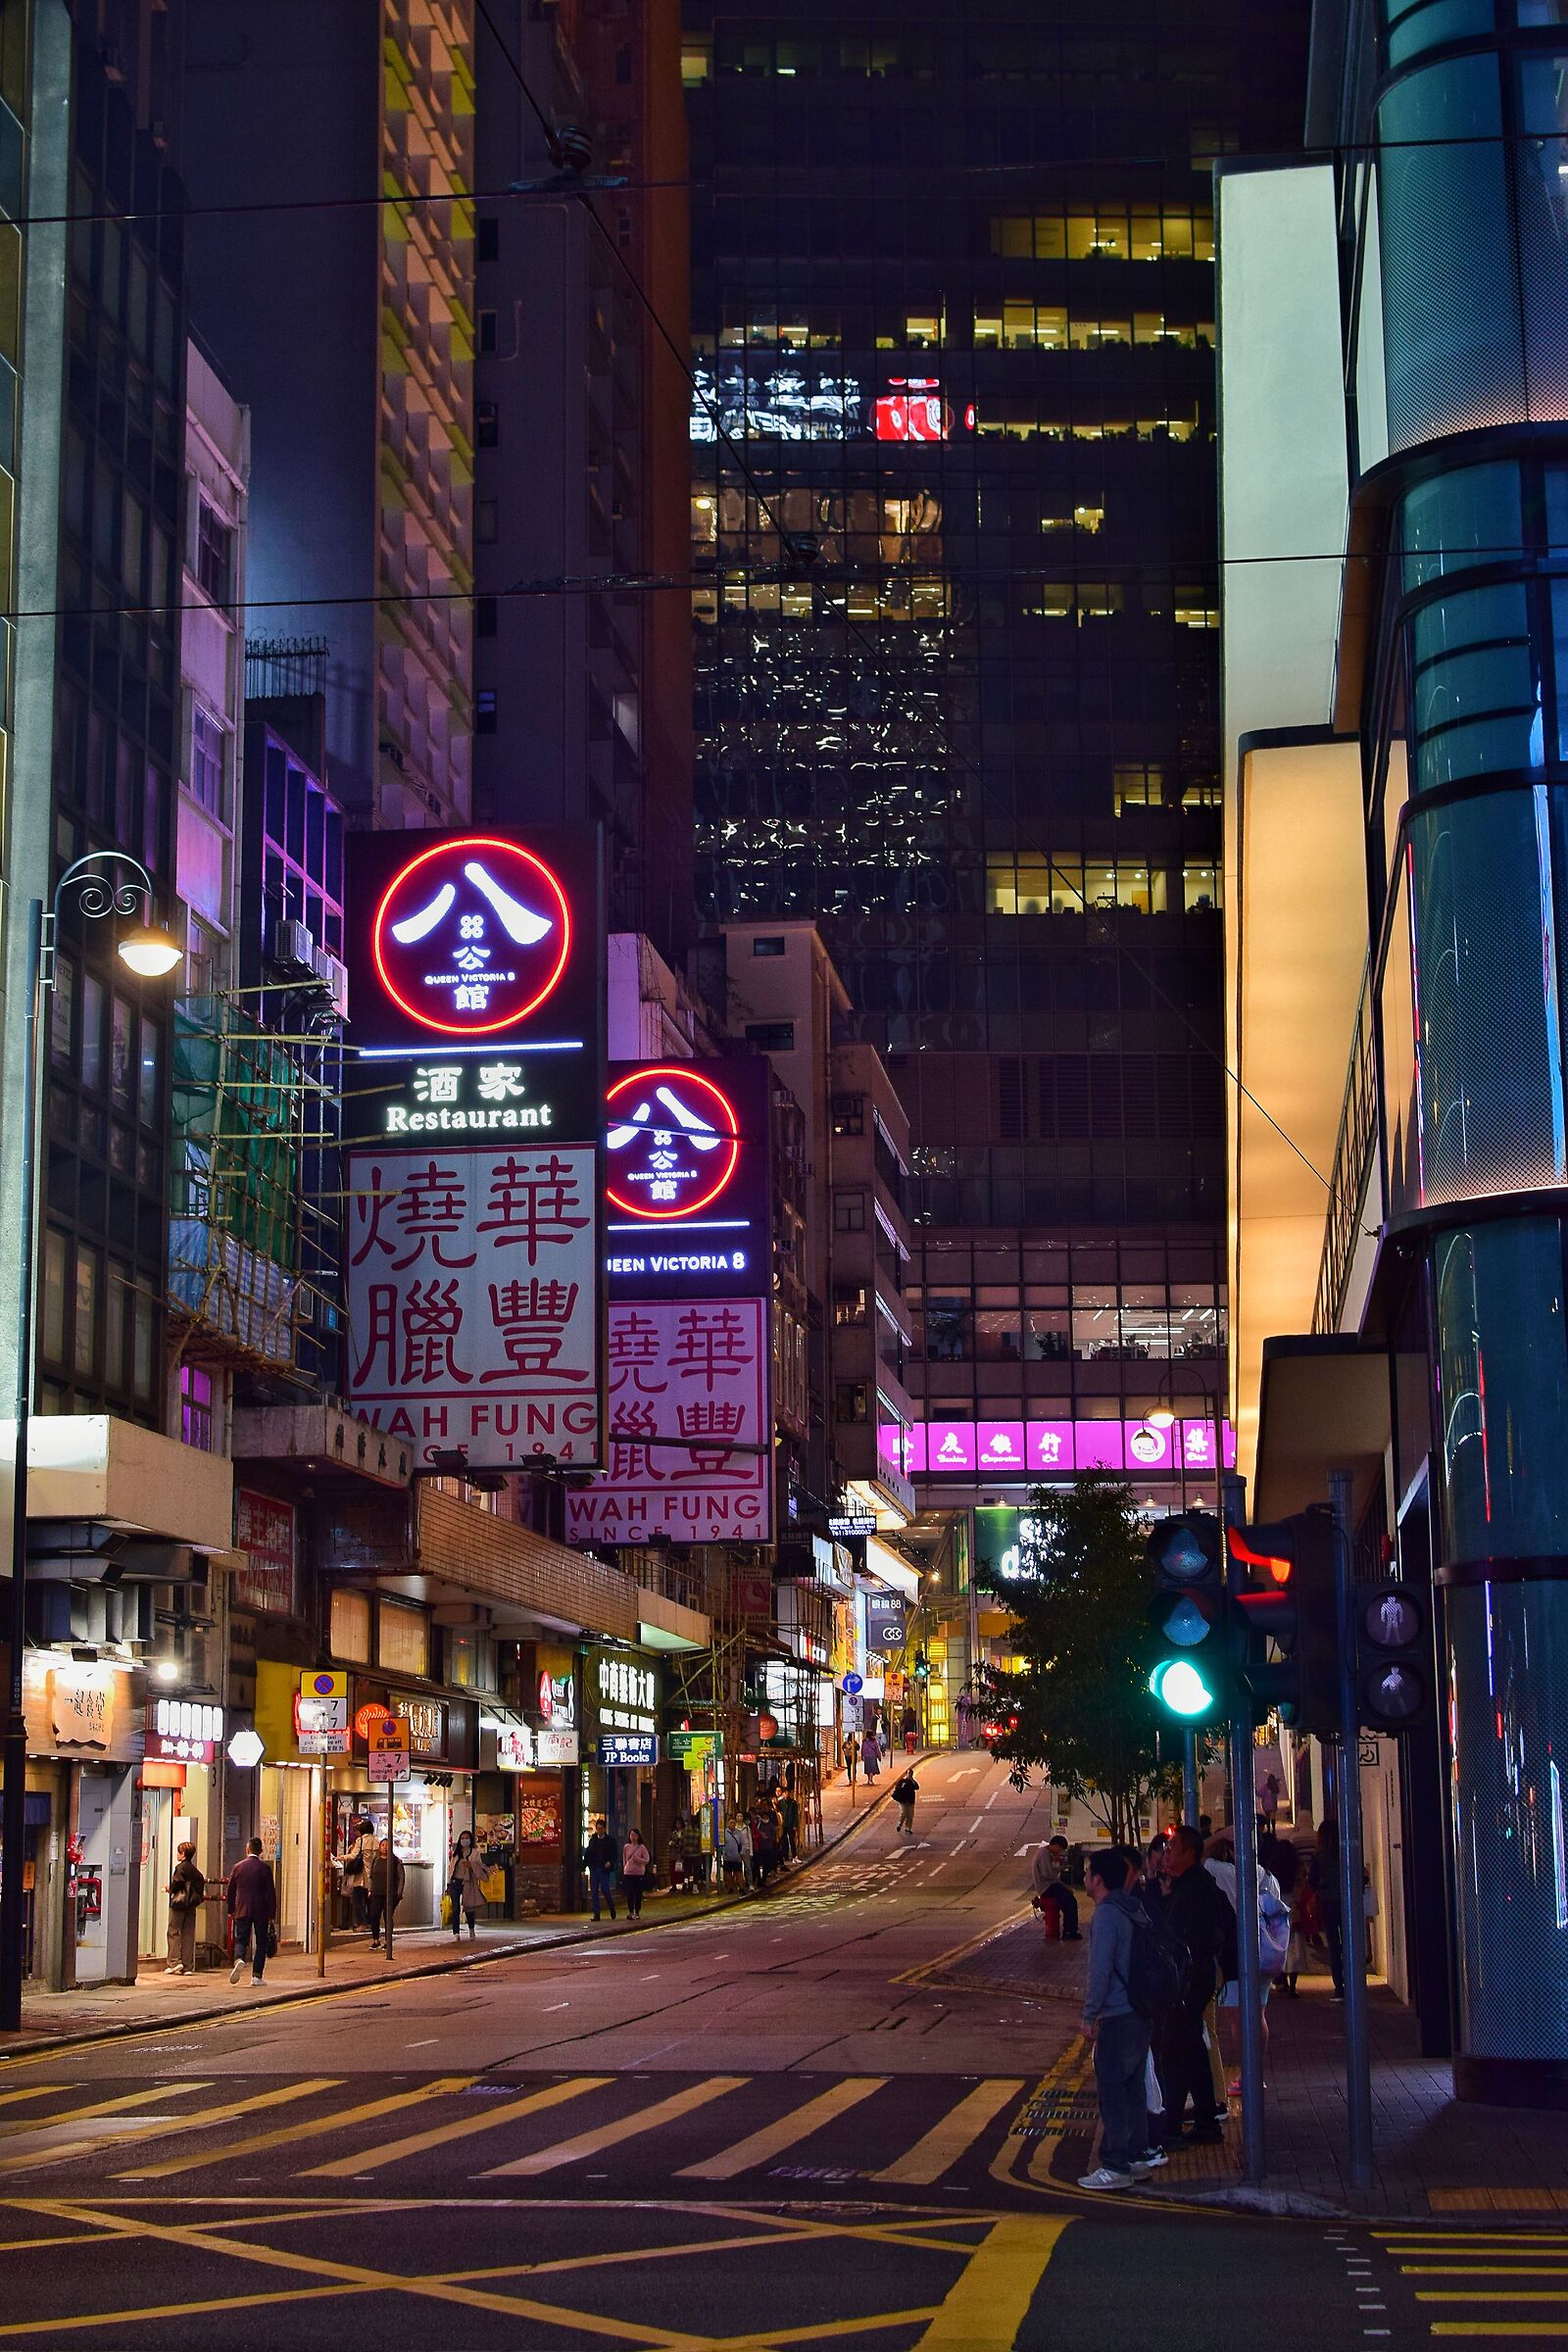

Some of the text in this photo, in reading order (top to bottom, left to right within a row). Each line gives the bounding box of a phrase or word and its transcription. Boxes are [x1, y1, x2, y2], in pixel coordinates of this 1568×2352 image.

[391, 861, 554, 946] 八
[453, 946, 491, 969] 公
[424, 972, 515, 986] QUEEN VICTORIA 8
[453, 984, 490, 1010] 館
[413, 1062, 525, 1102] 酒家
[386, 1103, 552, 1132] Restaurant
[648, 1150, 678, 1170] 公
[656, 1170, 690, 1180] VICTORIA
[607, 1252, 746, 1272] EEN VICTORIA 8
[470, 1401, 597, 1437] FUNG
[568, 1494, 760, 1522] WAH FUNG
[690, 1524, 761, 1540] 1941
[330, 1700, 339, 1711] 7
[330, 1718, 338, 1728] 7
[601, 1738, 652, 1750] 三聯書店
[394, 1753, 402, 1764] 7
[604, 1751, 650, 1763] JP Books
[212, 1766, 217, 1788] 3
[394, 1769, 408, 1780] 12
